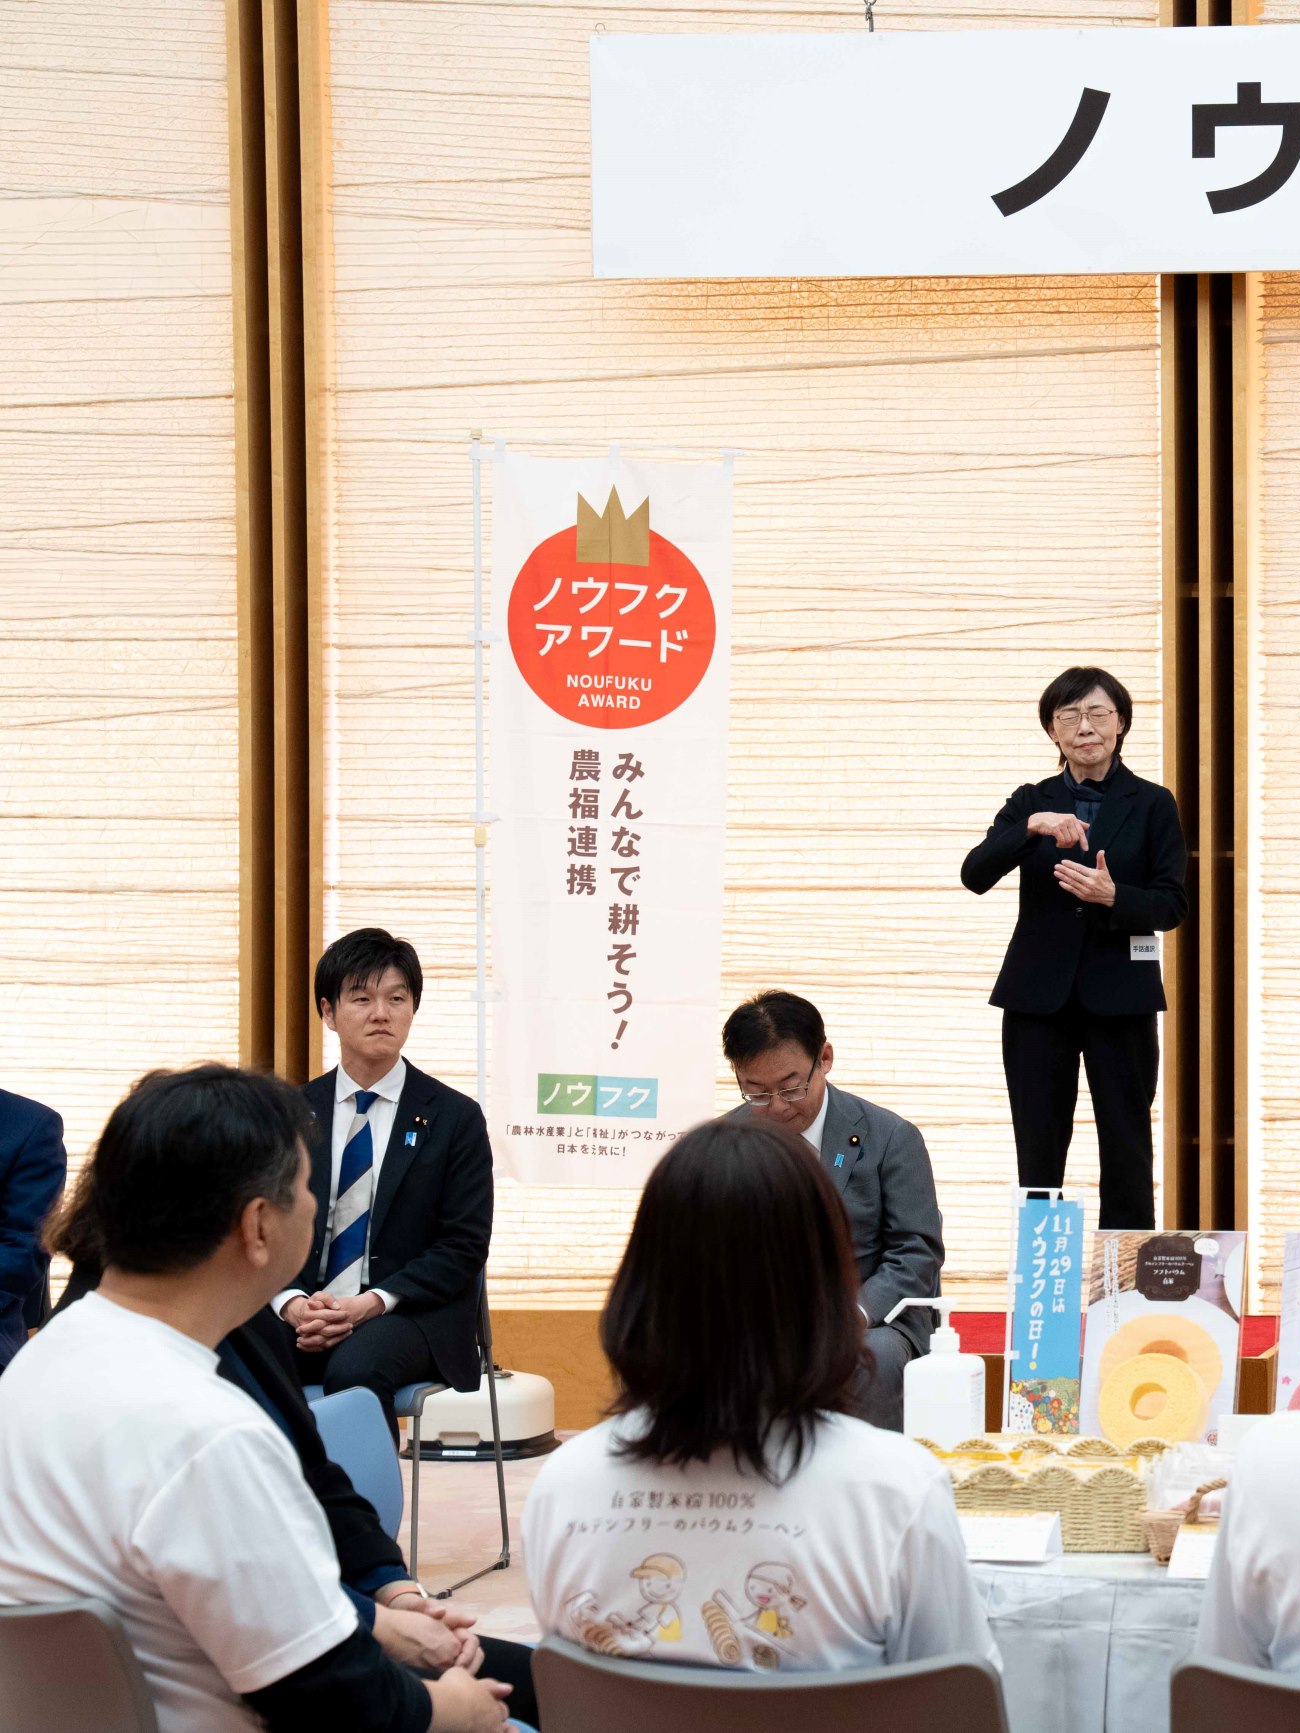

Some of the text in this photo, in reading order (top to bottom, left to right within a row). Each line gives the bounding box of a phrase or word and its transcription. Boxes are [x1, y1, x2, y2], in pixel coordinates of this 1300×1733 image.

[533, 576, 689, 619] ノウフク
[535, 623, 689, 663] アワード
[566, 674, 652, 692] NOUFUKU
[577, 693, 641, 710] AWARD
[566, 749, 602, 896] 農福連携
[543, 1082, 651, 1110] ノウフク
[1050, 1214, 1074, 1313] 11月29日は
